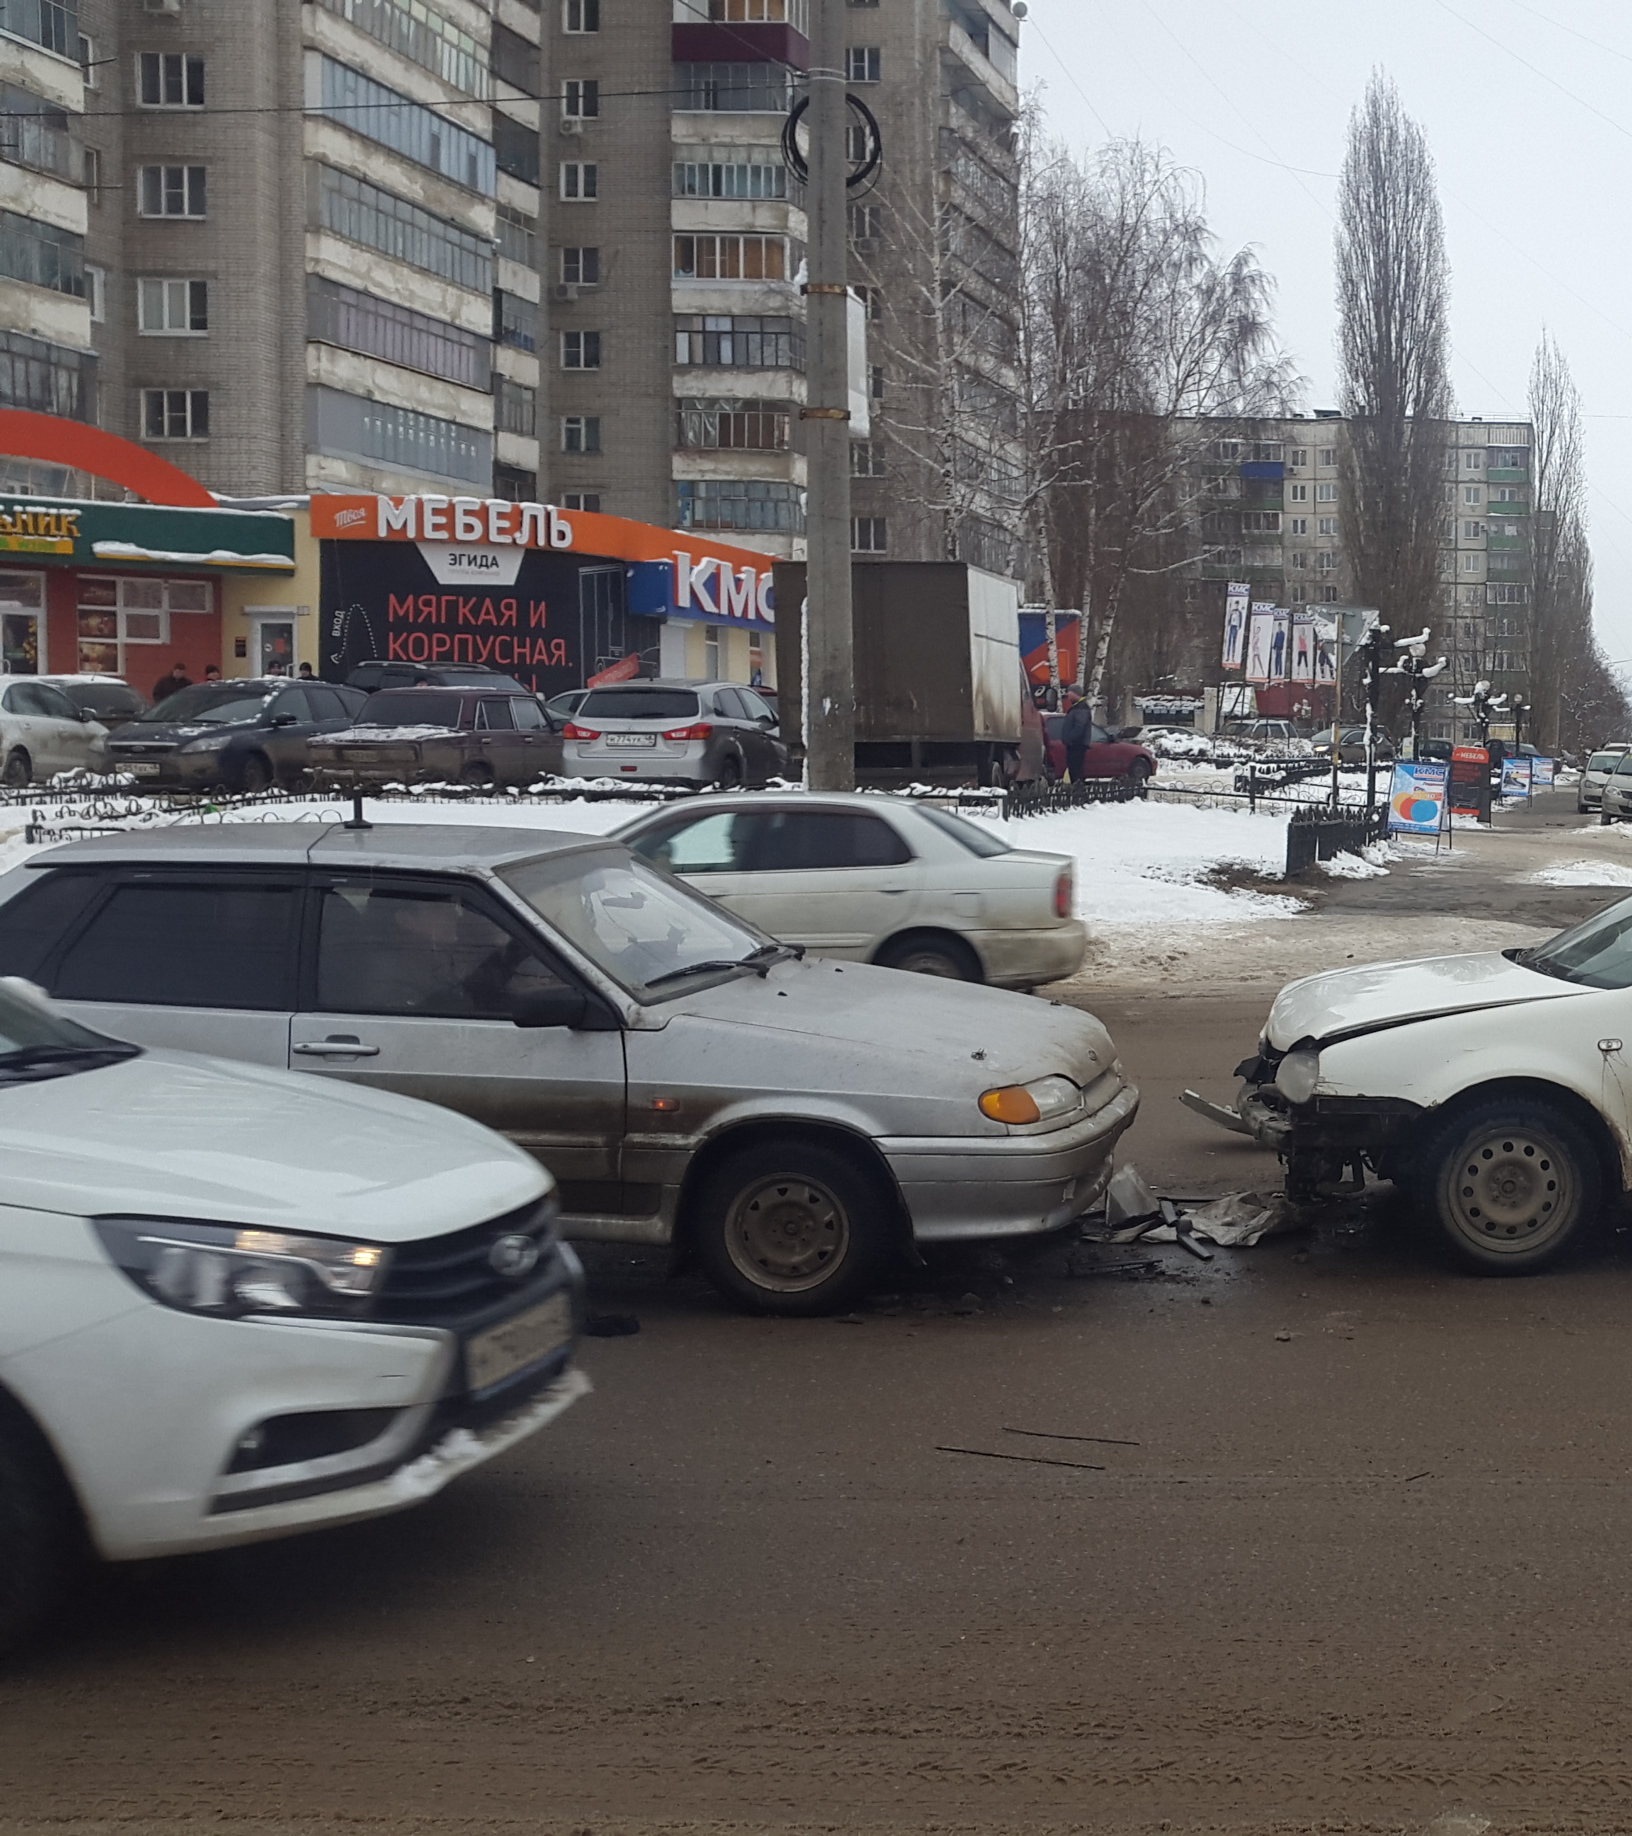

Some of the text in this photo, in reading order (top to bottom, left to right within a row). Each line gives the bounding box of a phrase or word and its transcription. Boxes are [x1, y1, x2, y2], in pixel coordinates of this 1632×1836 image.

[377, 495, 573, 548] МЕБЕЛЬ
[448, 553, 499, 569] ЭГИДА
[331, 610, 345, 637] ВХОД
[388, 593, 546, 628] МЯГКАЯ И
[388, 632, 574, 667] КОРПУСНАЯ.
[1460, 752, 1485, 760] МЕБЕЛЬ
